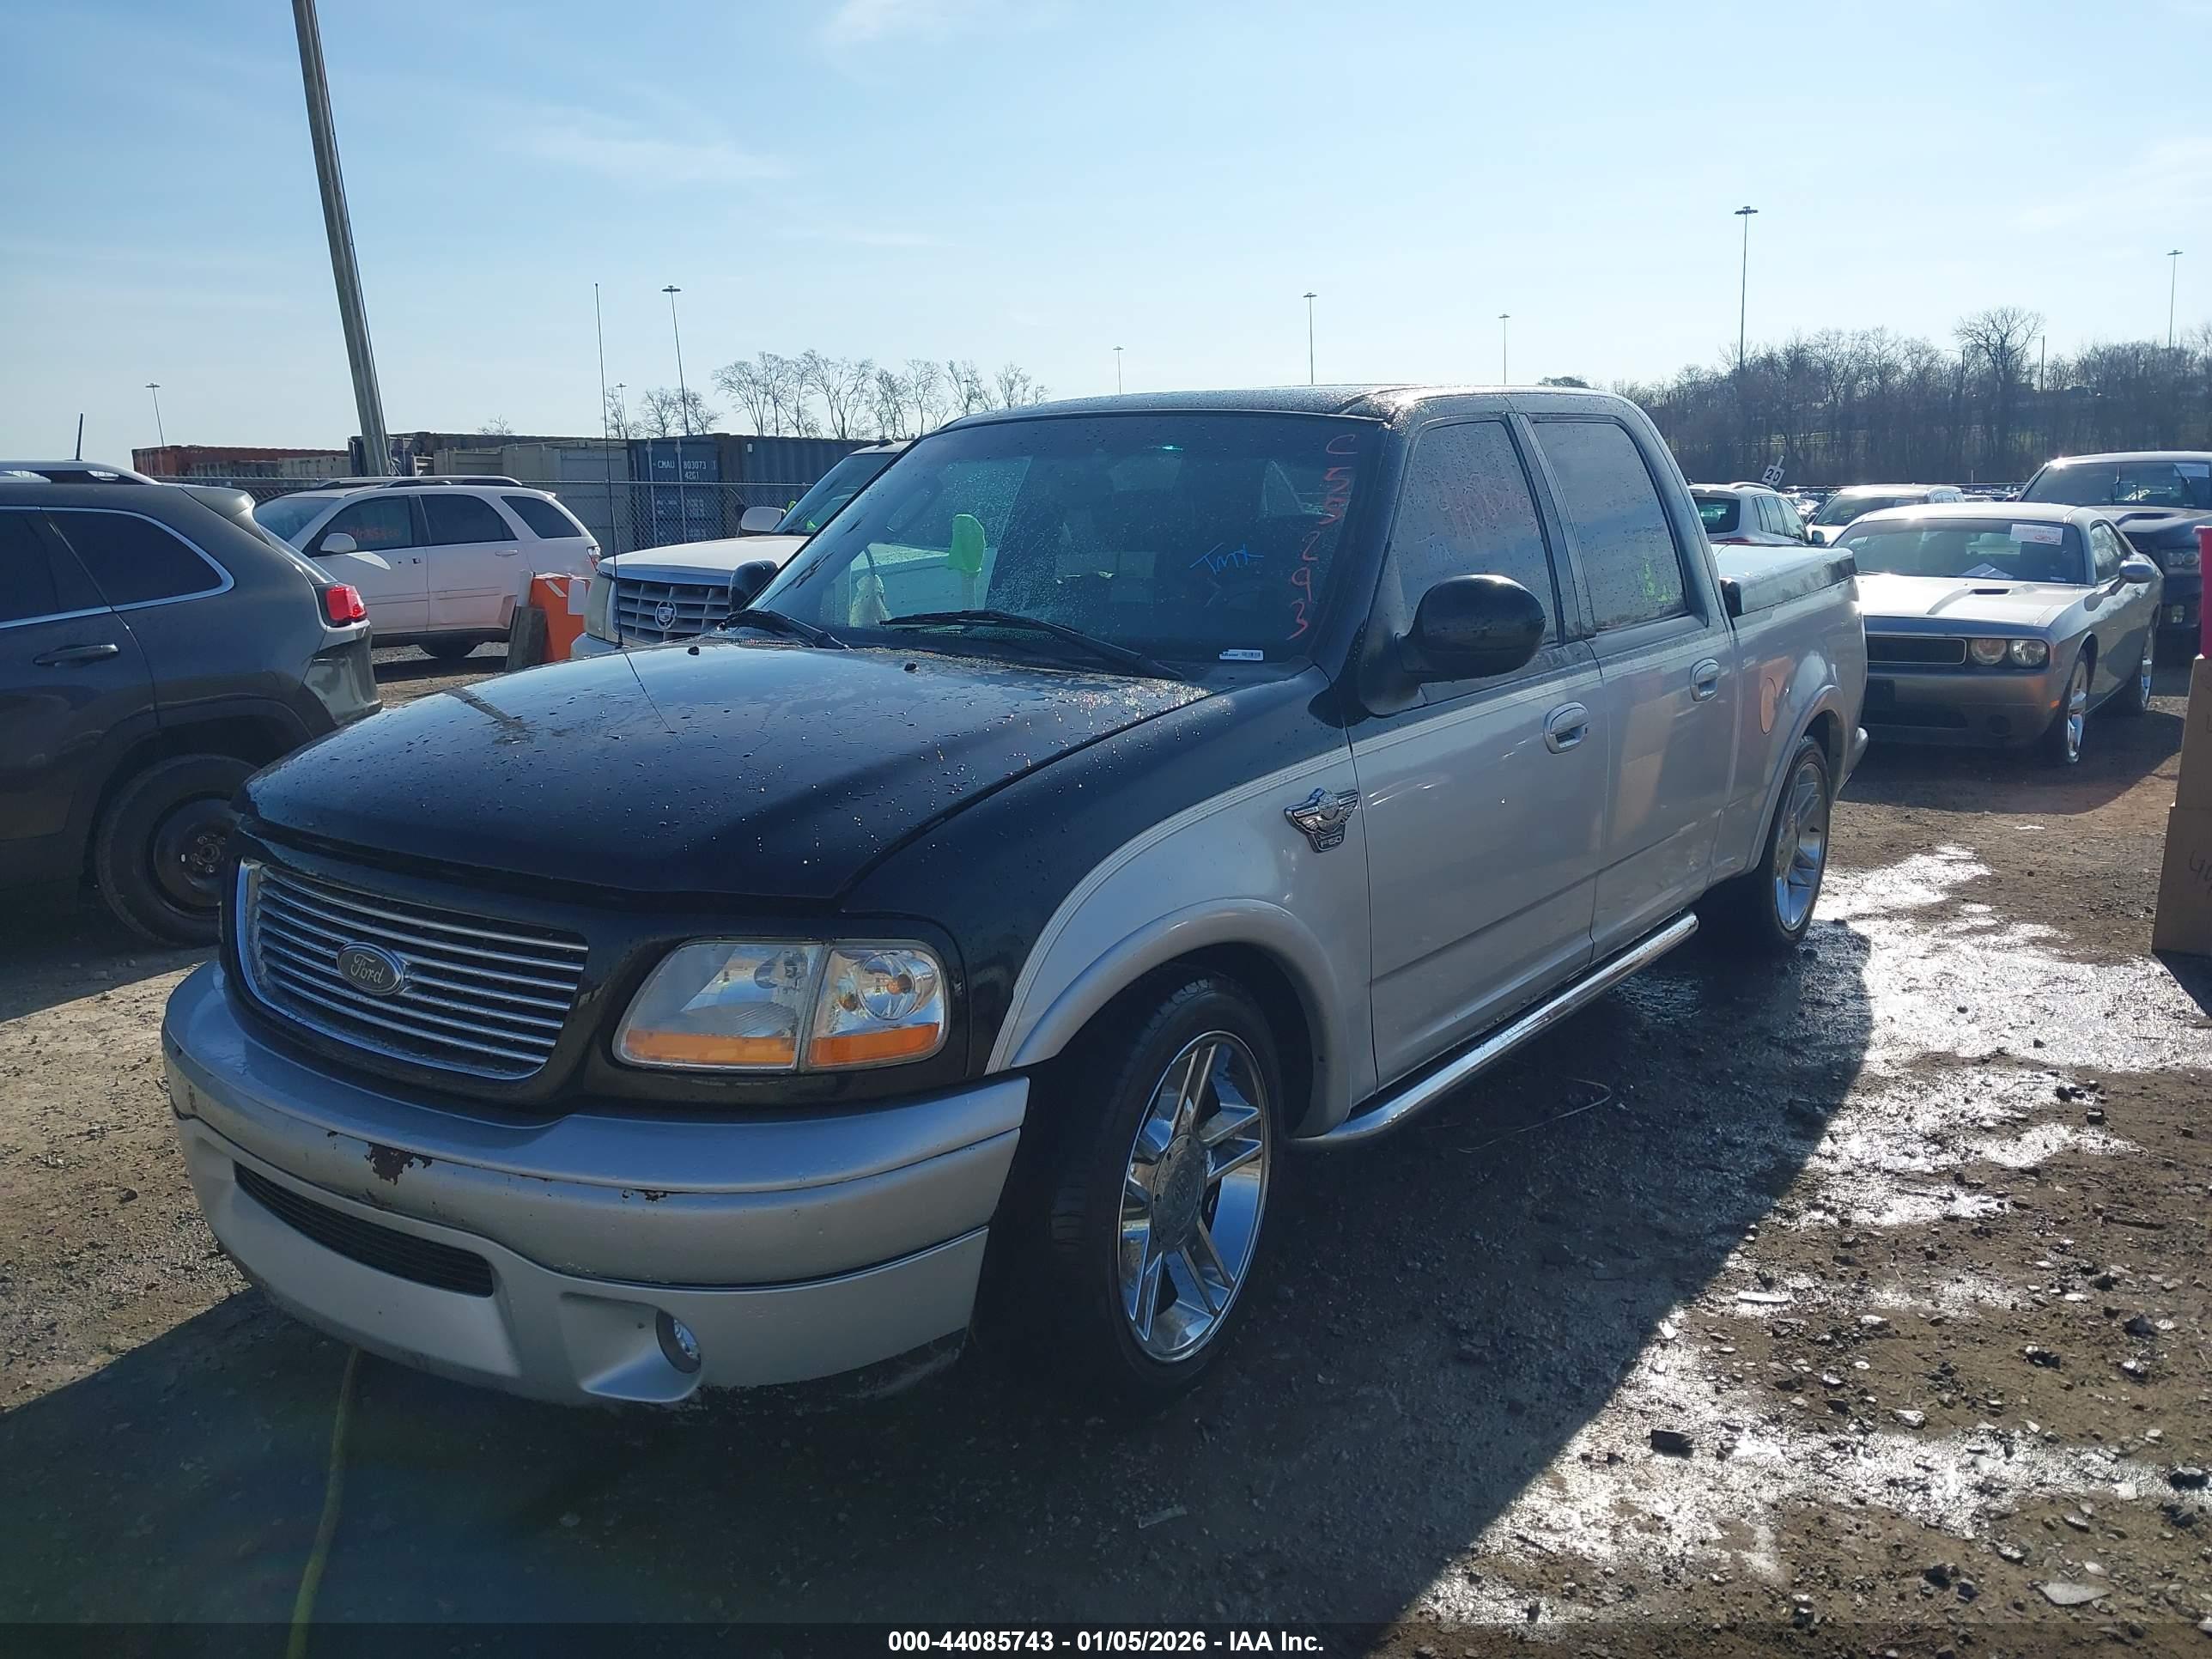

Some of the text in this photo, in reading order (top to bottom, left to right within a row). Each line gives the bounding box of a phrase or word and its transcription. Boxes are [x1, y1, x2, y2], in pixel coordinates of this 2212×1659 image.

[657, 460, 676, 470] CMAU
[683, 460, 707, 470] 803073
[1765, 468, 1781, 482] 20
[350, 953, 385, 984] Ford
